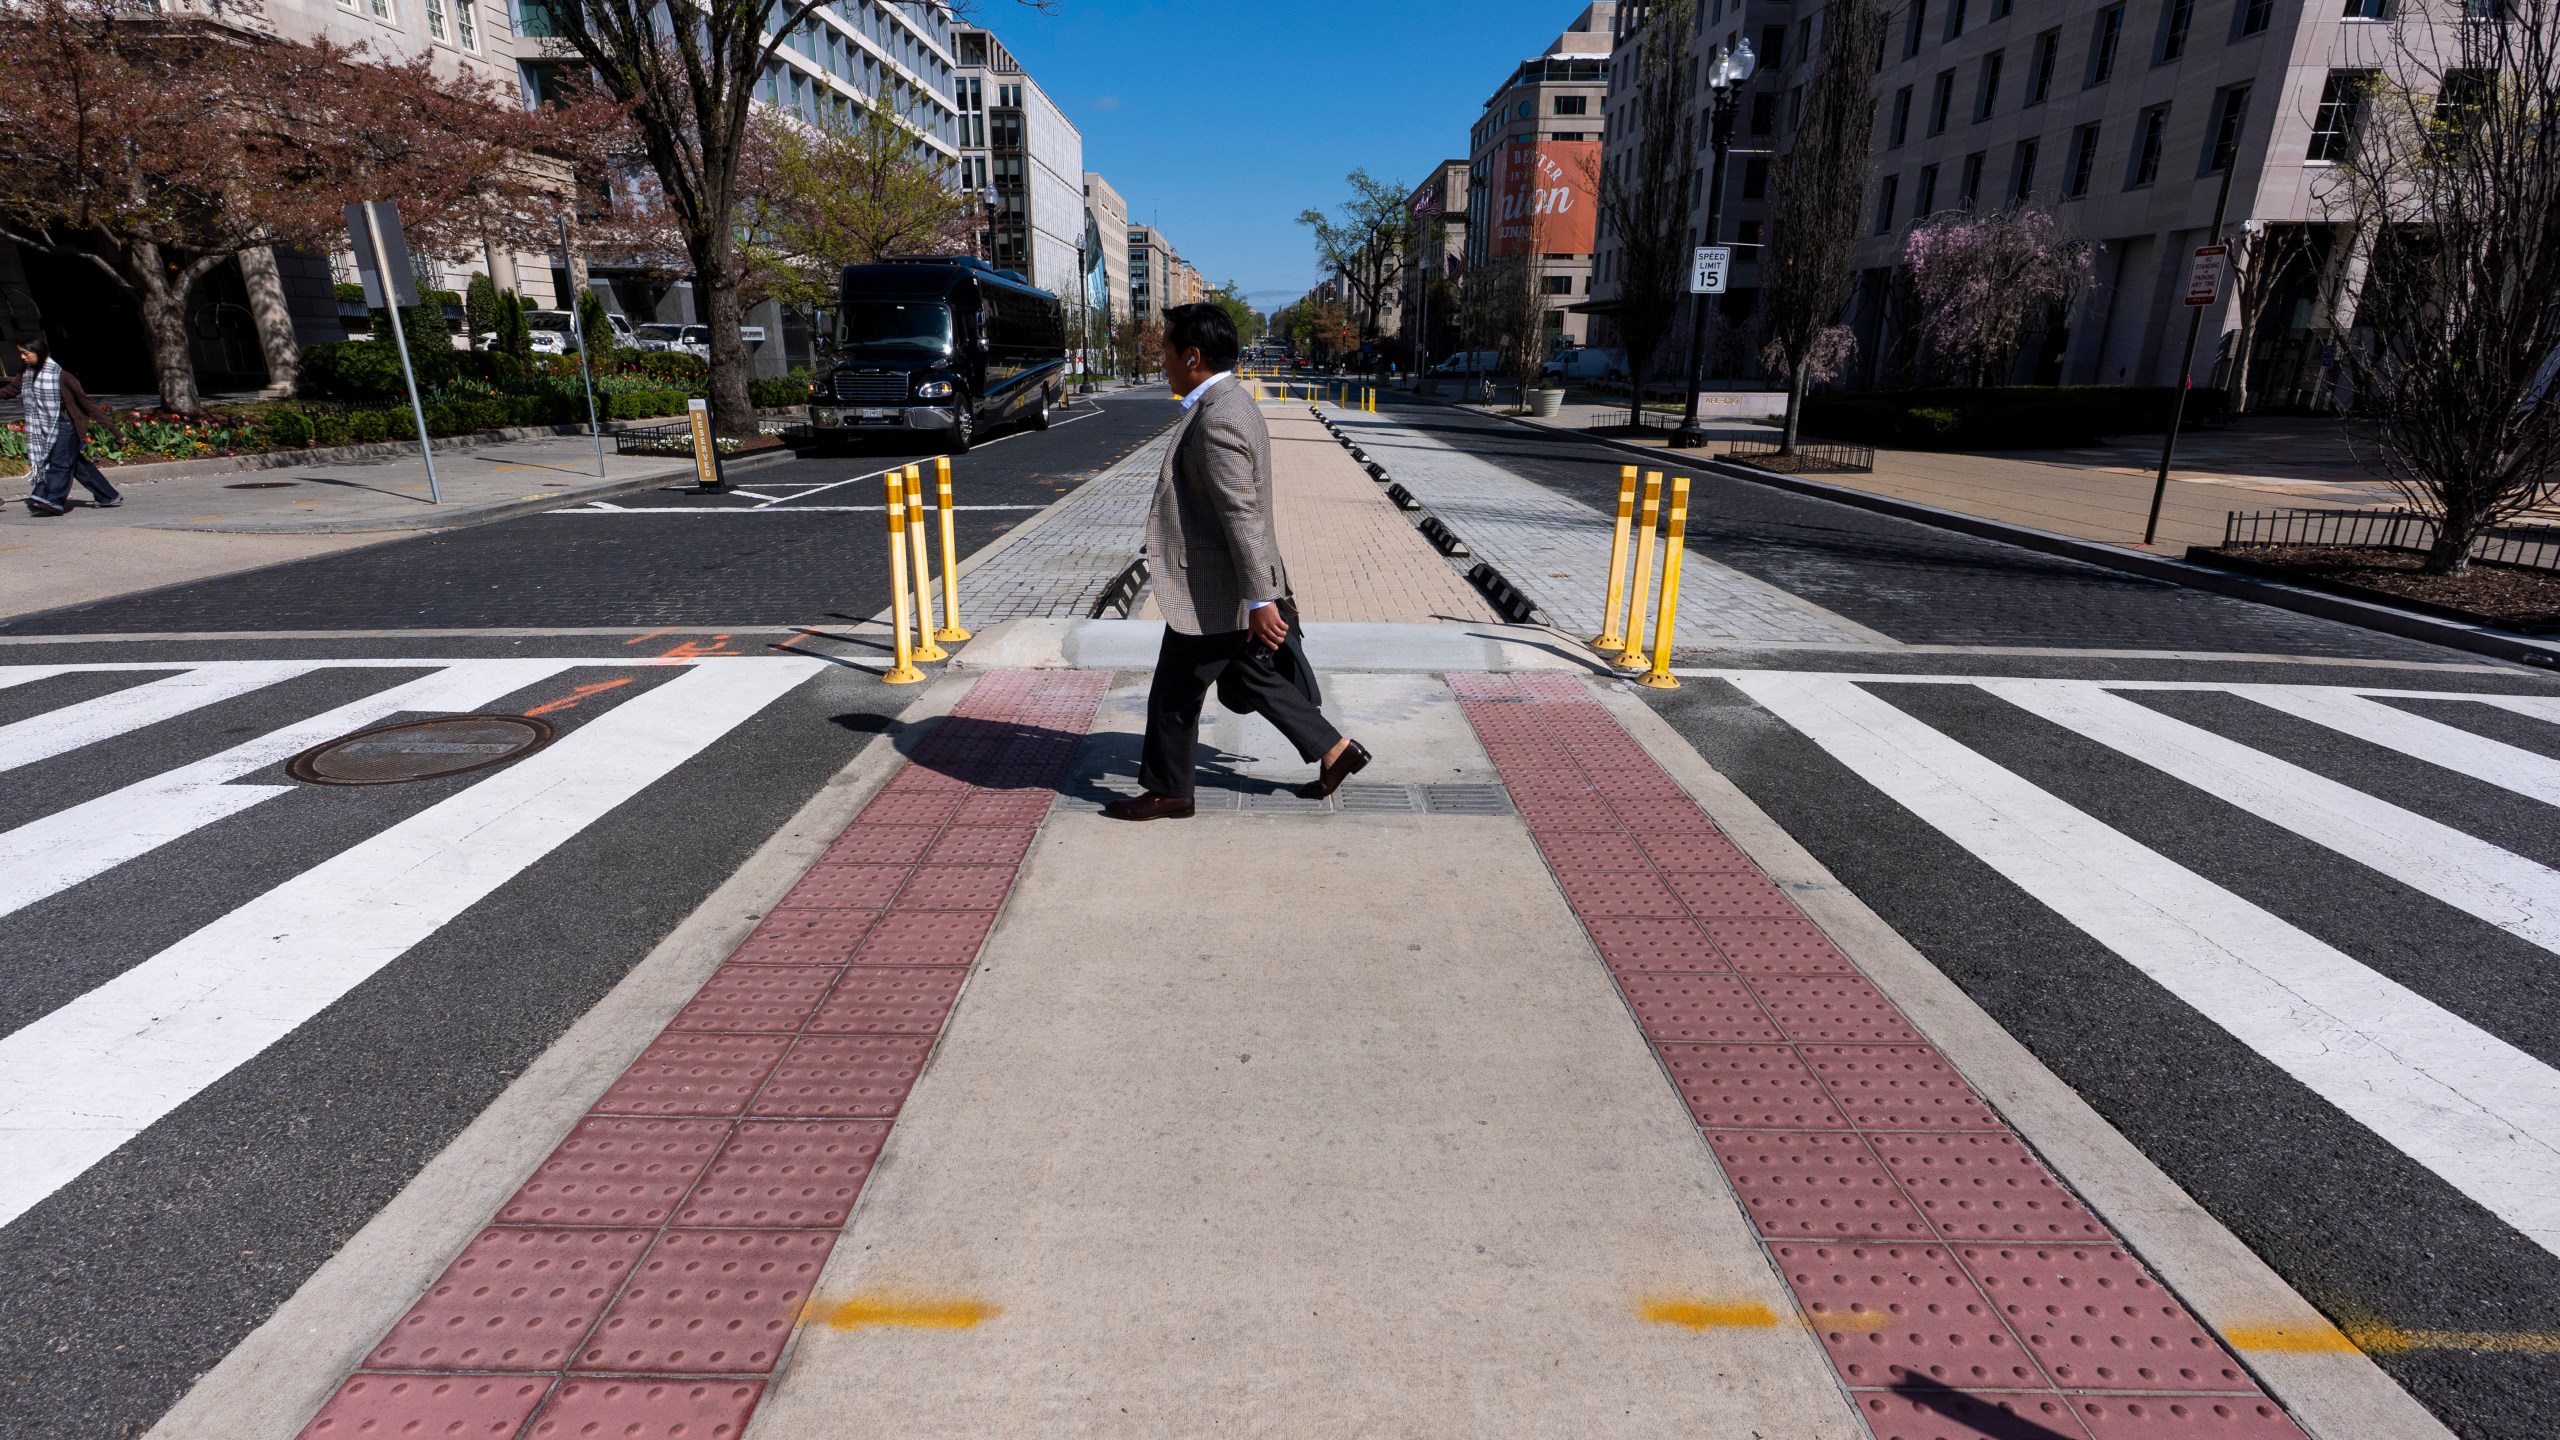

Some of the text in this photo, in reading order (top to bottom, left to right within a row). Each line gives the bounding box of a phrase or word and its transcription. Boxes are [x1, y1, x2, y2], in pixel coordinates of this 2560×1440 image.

[1699, 262, 1721, 270] LIMIT
[2195, 262, 2219, 270] STANDING
[1700, 271, 1718, 287] 15
[1705, 397, 1739, 405] AFL-CIO
[696, 413, 711, 477] RESERVED
